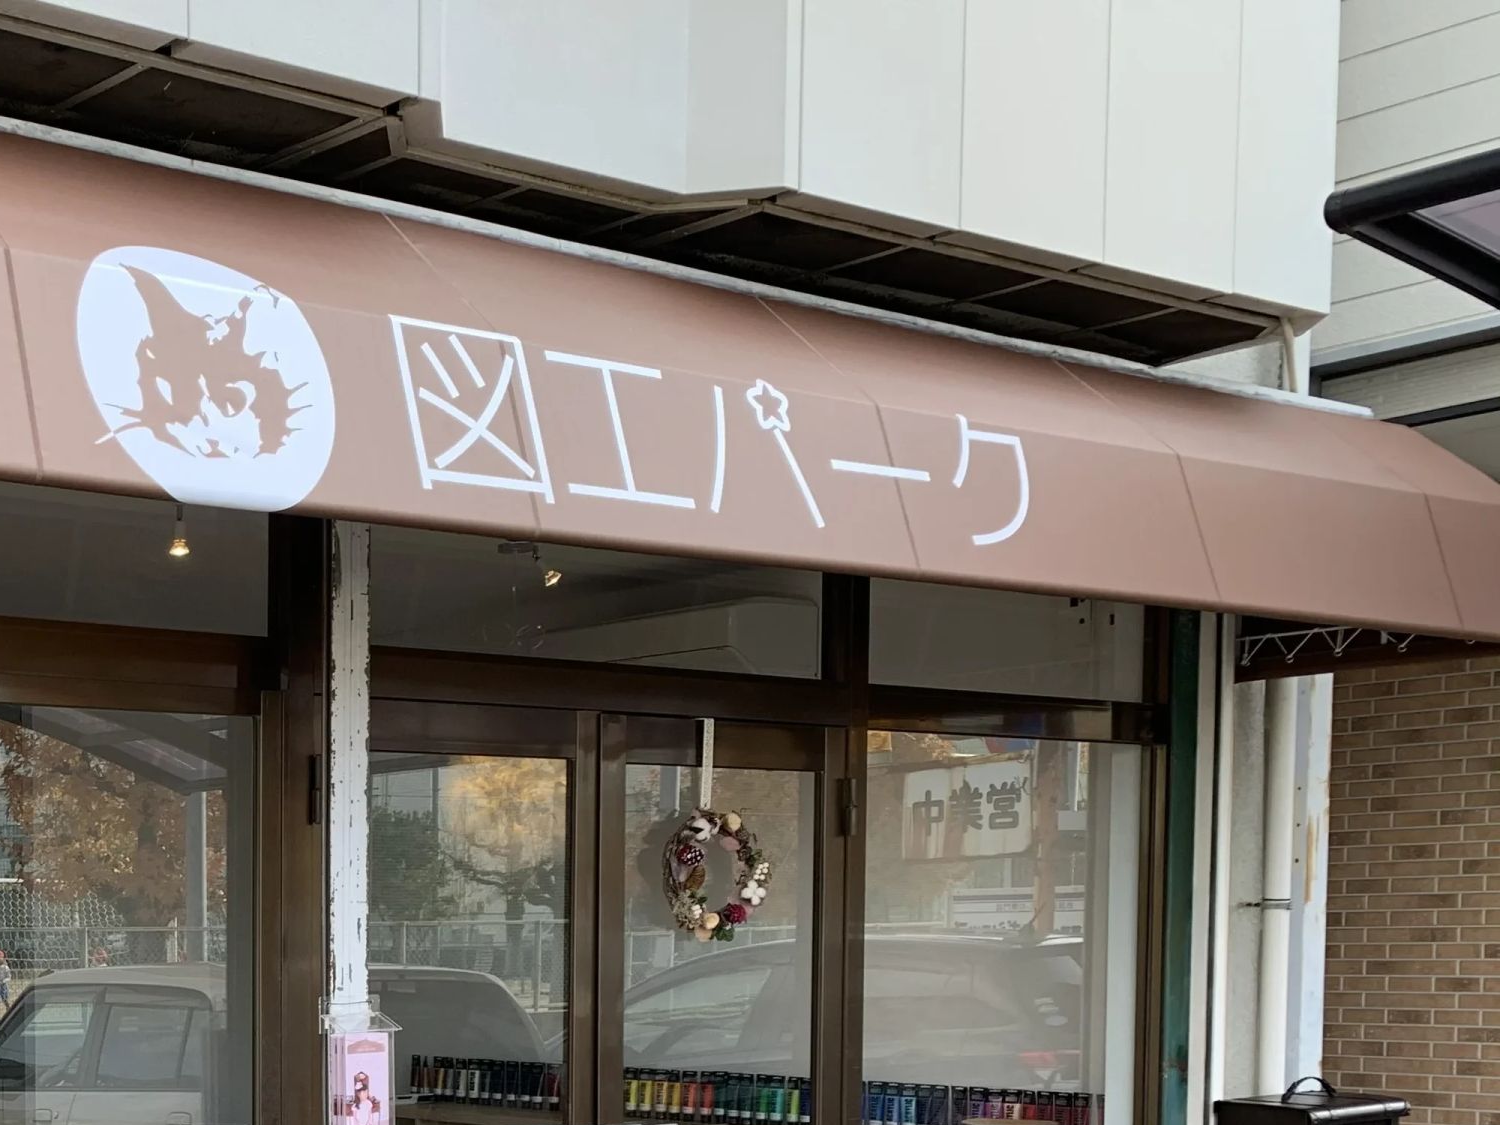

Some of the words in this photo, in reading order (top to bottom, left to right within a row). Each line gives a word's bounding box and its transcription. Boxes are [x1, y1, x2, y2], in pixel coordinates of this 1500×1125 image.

[388, 314, 1030, 546] 図工パーク
